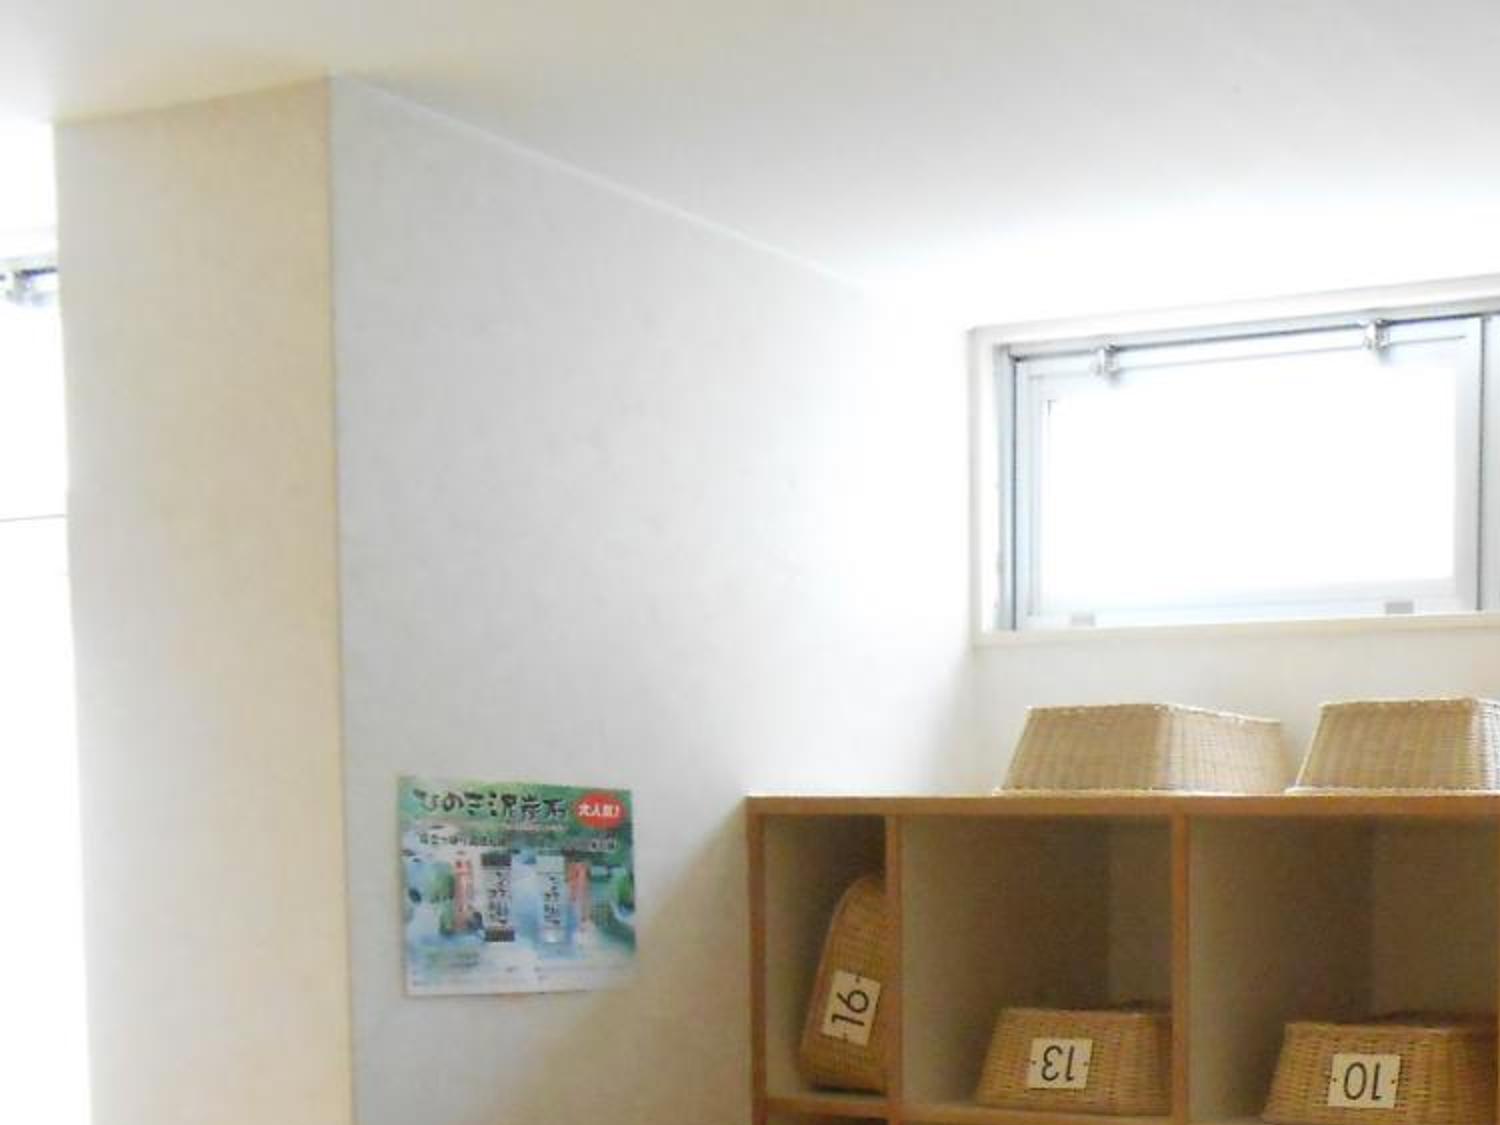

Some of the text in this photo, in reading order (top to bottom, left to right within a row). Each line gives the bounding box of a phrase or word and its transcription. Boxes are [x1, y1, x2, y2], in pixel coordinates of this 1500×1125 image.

[832, 989, 869, 1027] 16
[1040, 1045, 1075, 1081] 13
[1344, 1062, 1381, 1100] 10
